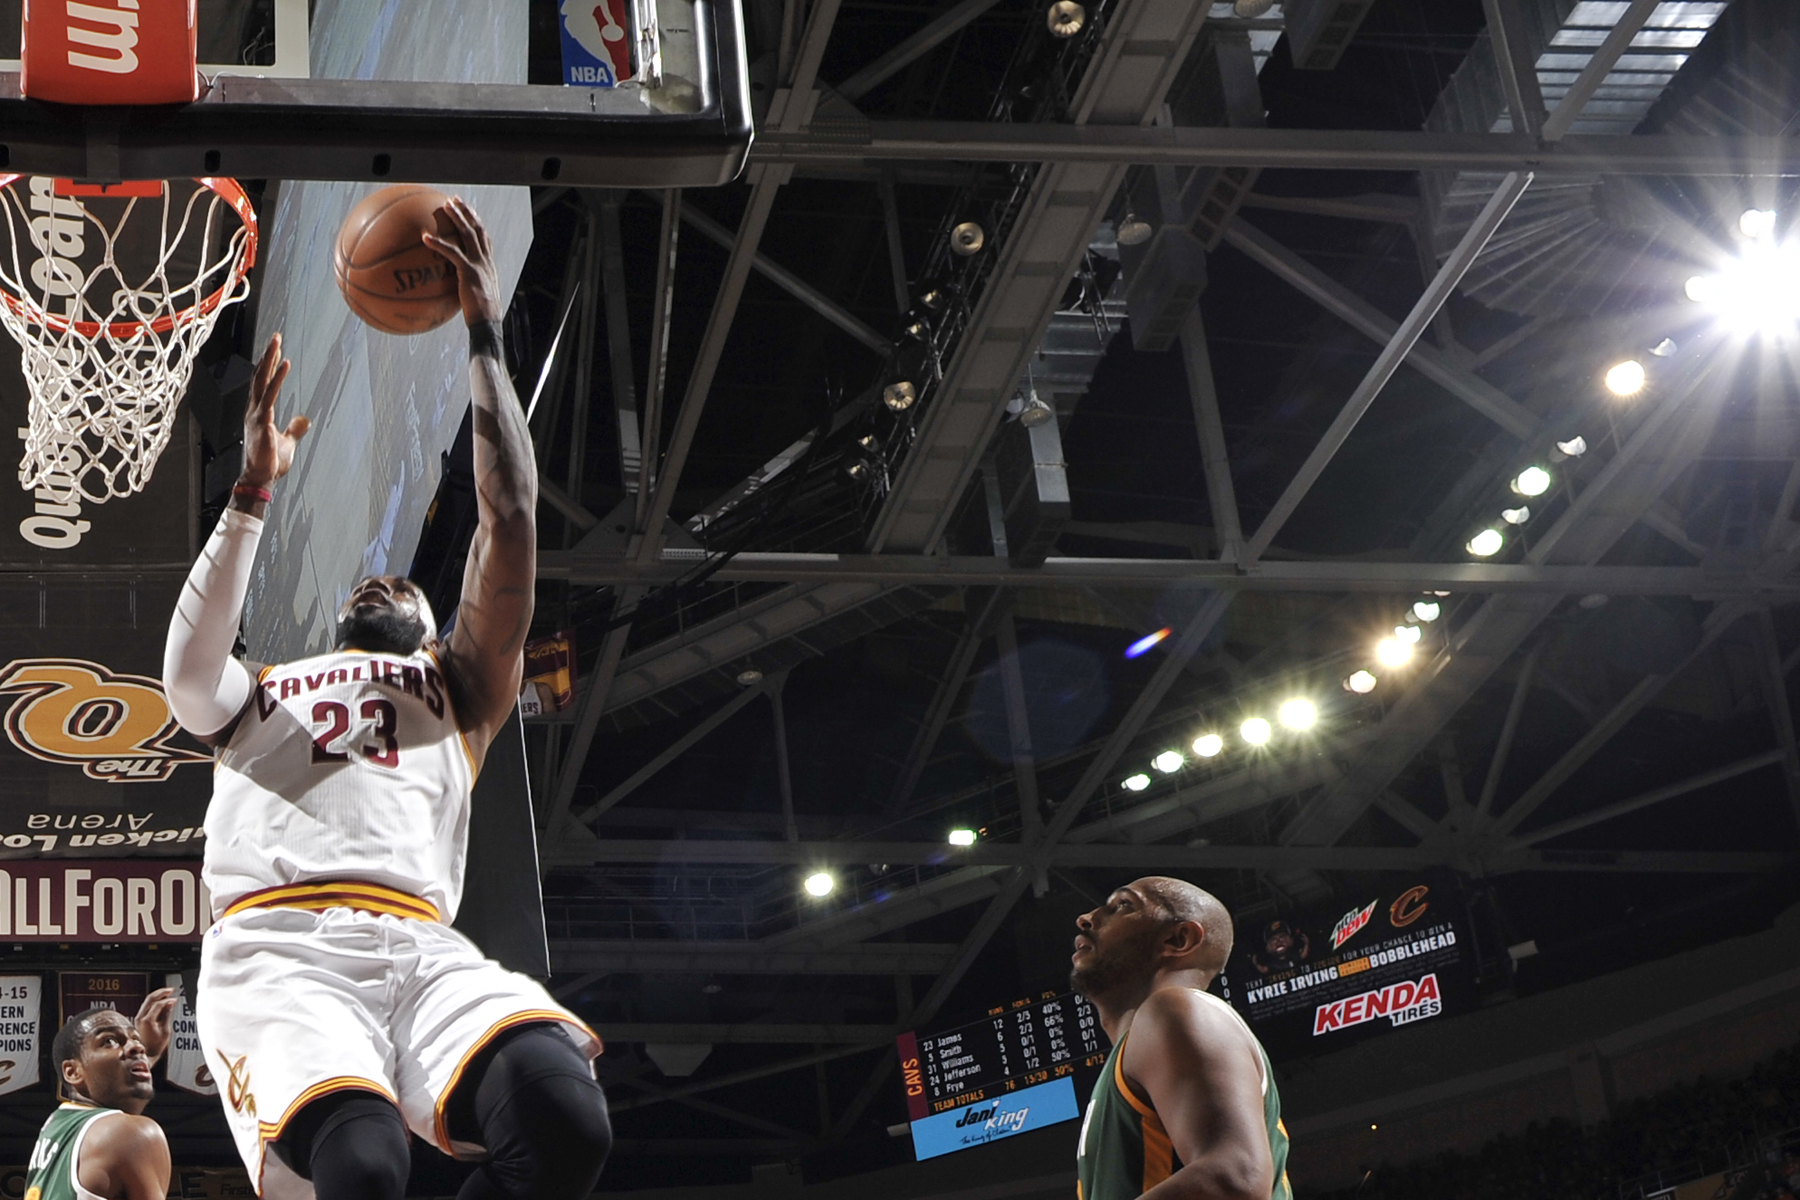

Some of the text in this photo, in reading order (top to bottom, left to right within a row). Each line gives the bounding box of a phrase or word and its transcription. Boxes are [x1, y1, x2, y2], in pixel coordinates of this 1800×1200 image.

[570, 67, 609, 83] NBA
[257, 661, 445, 722] CAVALIERS
[311, 700, 399, 769] 23
[96, 760, 163, 776] The
[27, 812, 154, 831] Arena
[1247, 932, 1457, 1004] KYRIE IRVING BOBBLEHEAD
[88, 979, 120, 990] 2016
[1316, 977, 1437, 1032] KENDA
[1392, 1001, 1439, 1023] TIRES
[939, 1045, 963, 1060] Smith
[903, 1057, 923, 1097] CAVS
[943, 1063, 982, 1082] Jefferson
[946, 1080, 964, 1094] Frye
[933, 1088, 985, 1112] TEAM TOTALS
[955, 1100, 999, 1129] Jani
